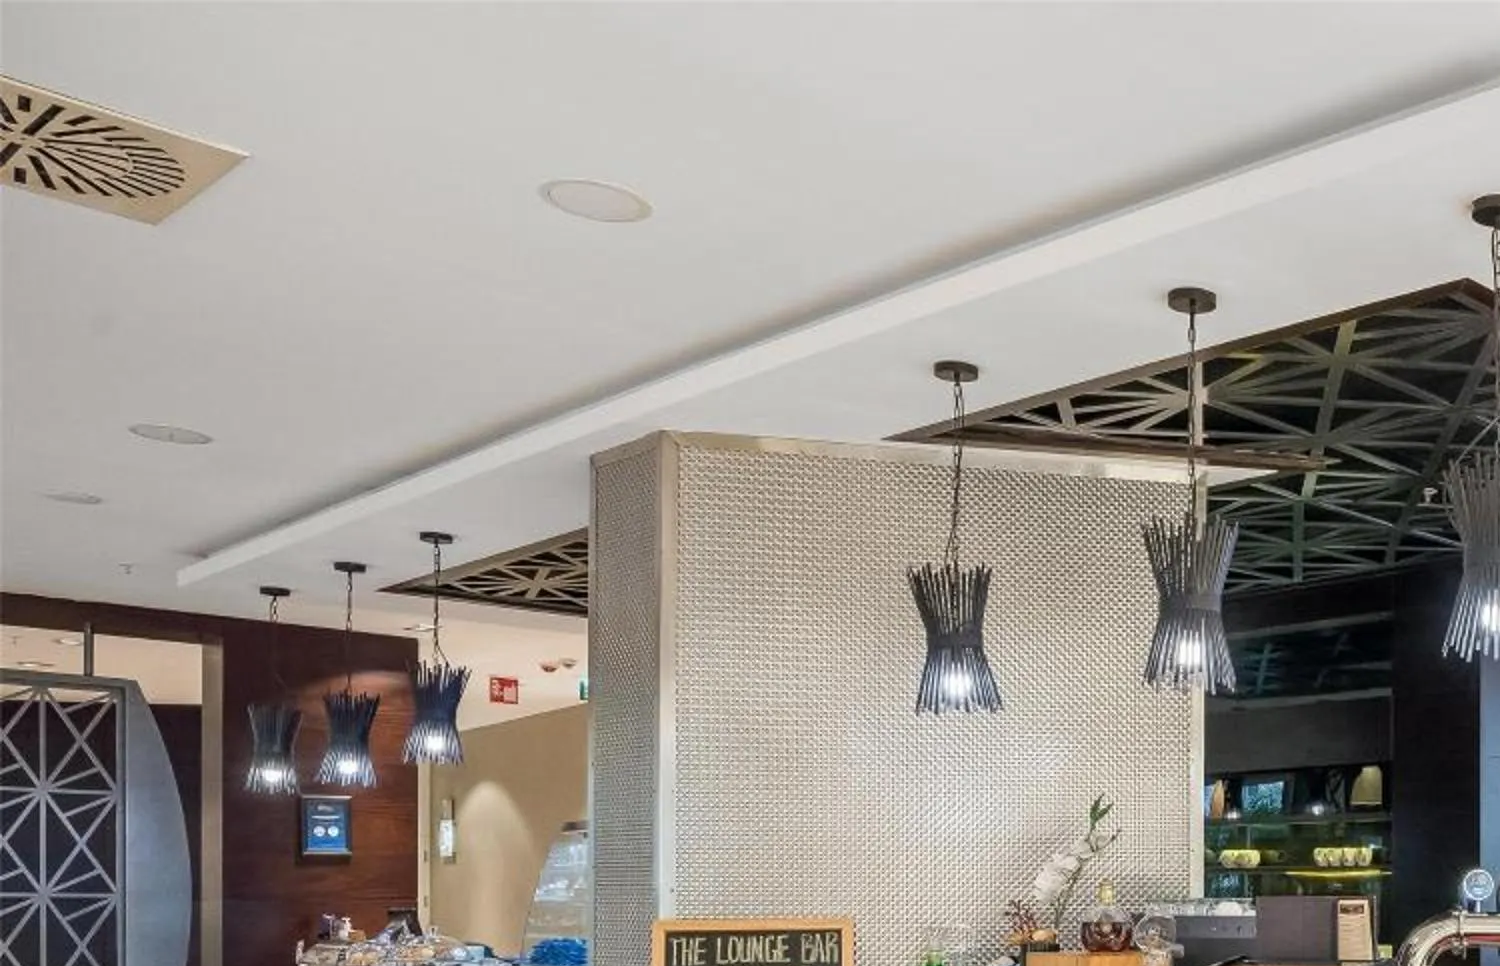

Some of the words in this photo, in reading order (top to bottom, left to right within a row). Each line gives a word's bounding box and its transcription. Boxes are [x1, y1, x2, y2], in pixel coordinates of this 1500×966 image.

[671, 937, 707, 966] THE
[715, 934, 791, 965] LOUNGE
[800, 931, 839, 964] BAR
